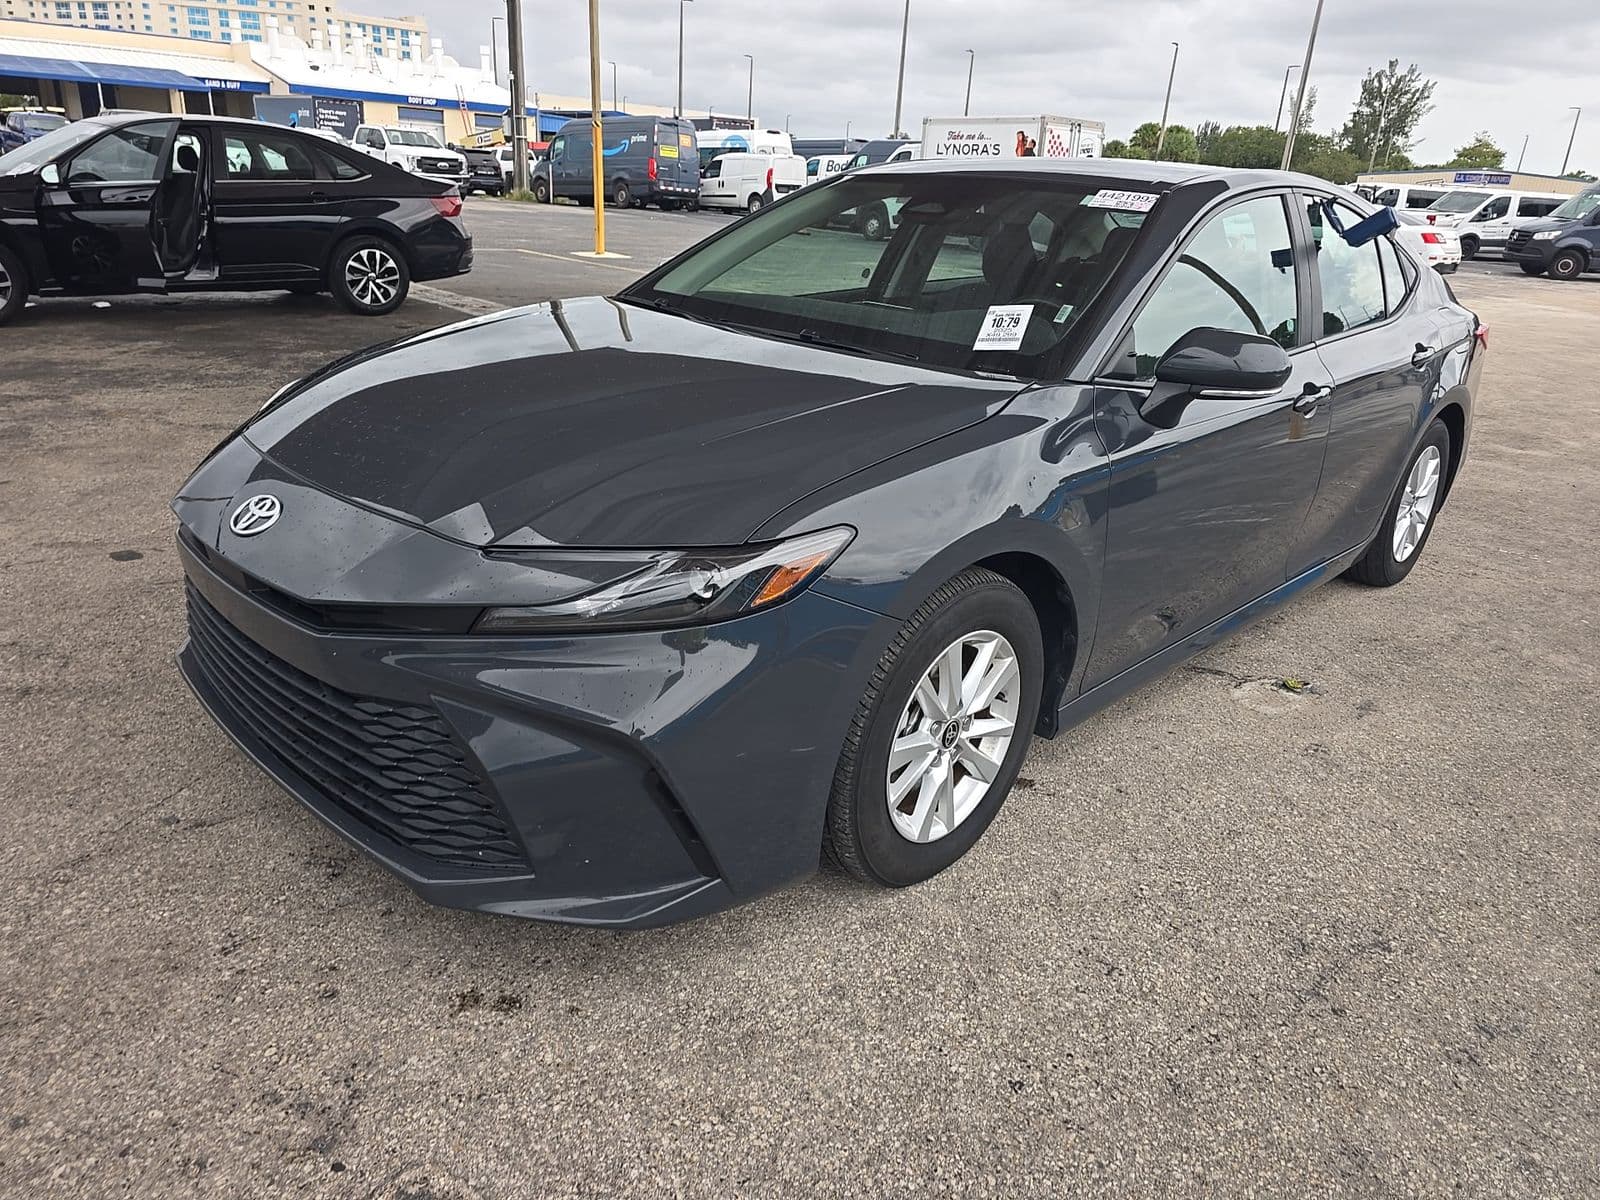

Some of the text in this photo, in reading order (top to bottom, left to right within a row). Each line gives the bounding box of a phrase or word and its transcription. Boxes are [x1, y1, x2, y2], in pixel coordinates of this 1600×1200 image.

[408, 97, 422, 105] BODY
[631, 133, 647, 144] prime
[947, 130, 964, 141] Take
[936, 143, 1001, 156] LYNORA'S
[991, 317, 1020, 328] 10:79
